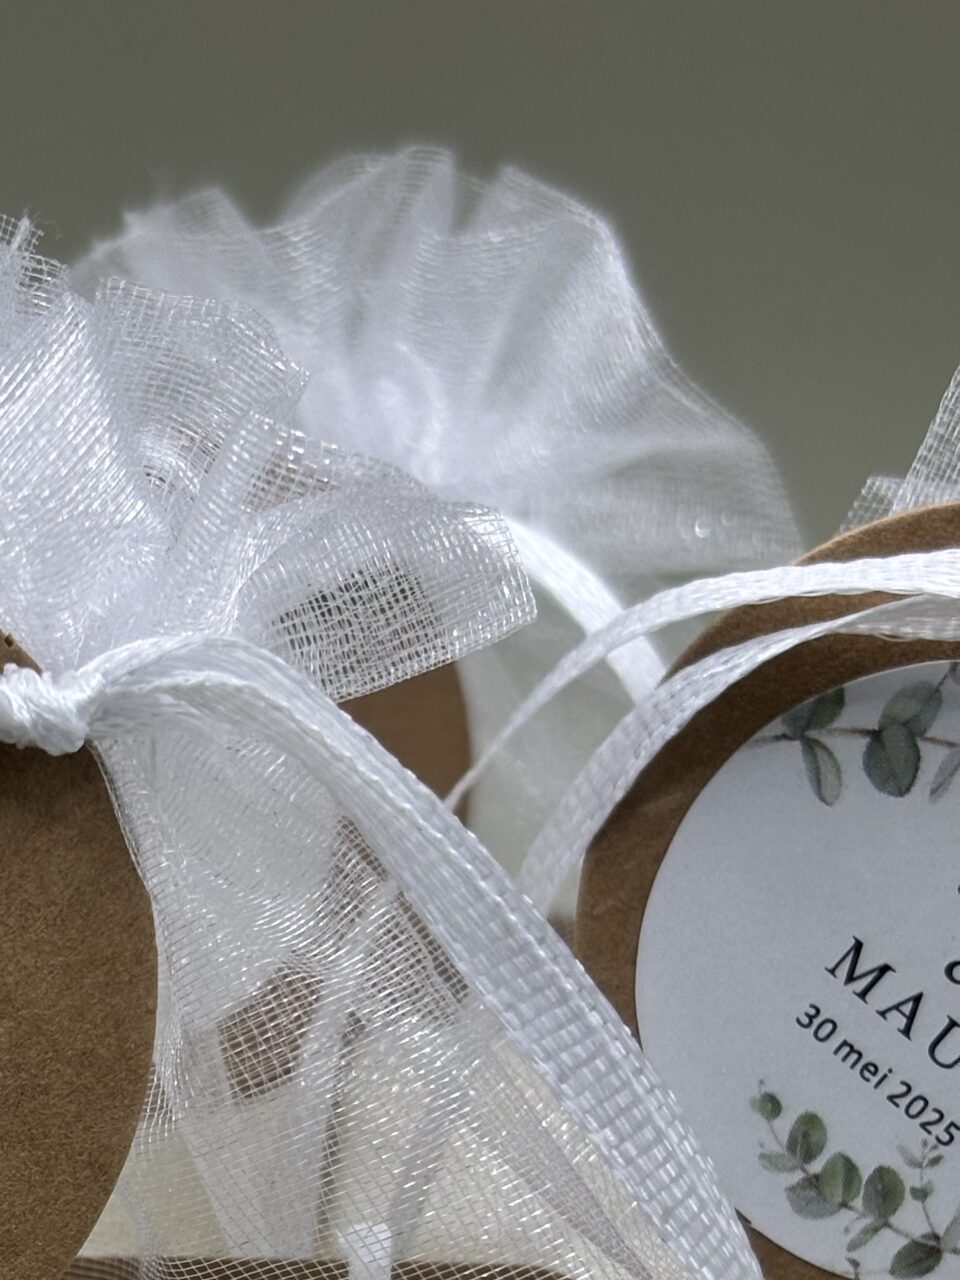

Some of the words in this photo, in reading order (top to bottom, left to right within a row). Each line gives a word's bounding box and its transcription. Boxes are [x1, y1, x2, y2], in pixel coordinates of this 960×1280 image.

[796, 1003, 838, 1043] 30
[833, 1039, 893, 1090] mei
[886, 1080, 960, 1147] 2025
